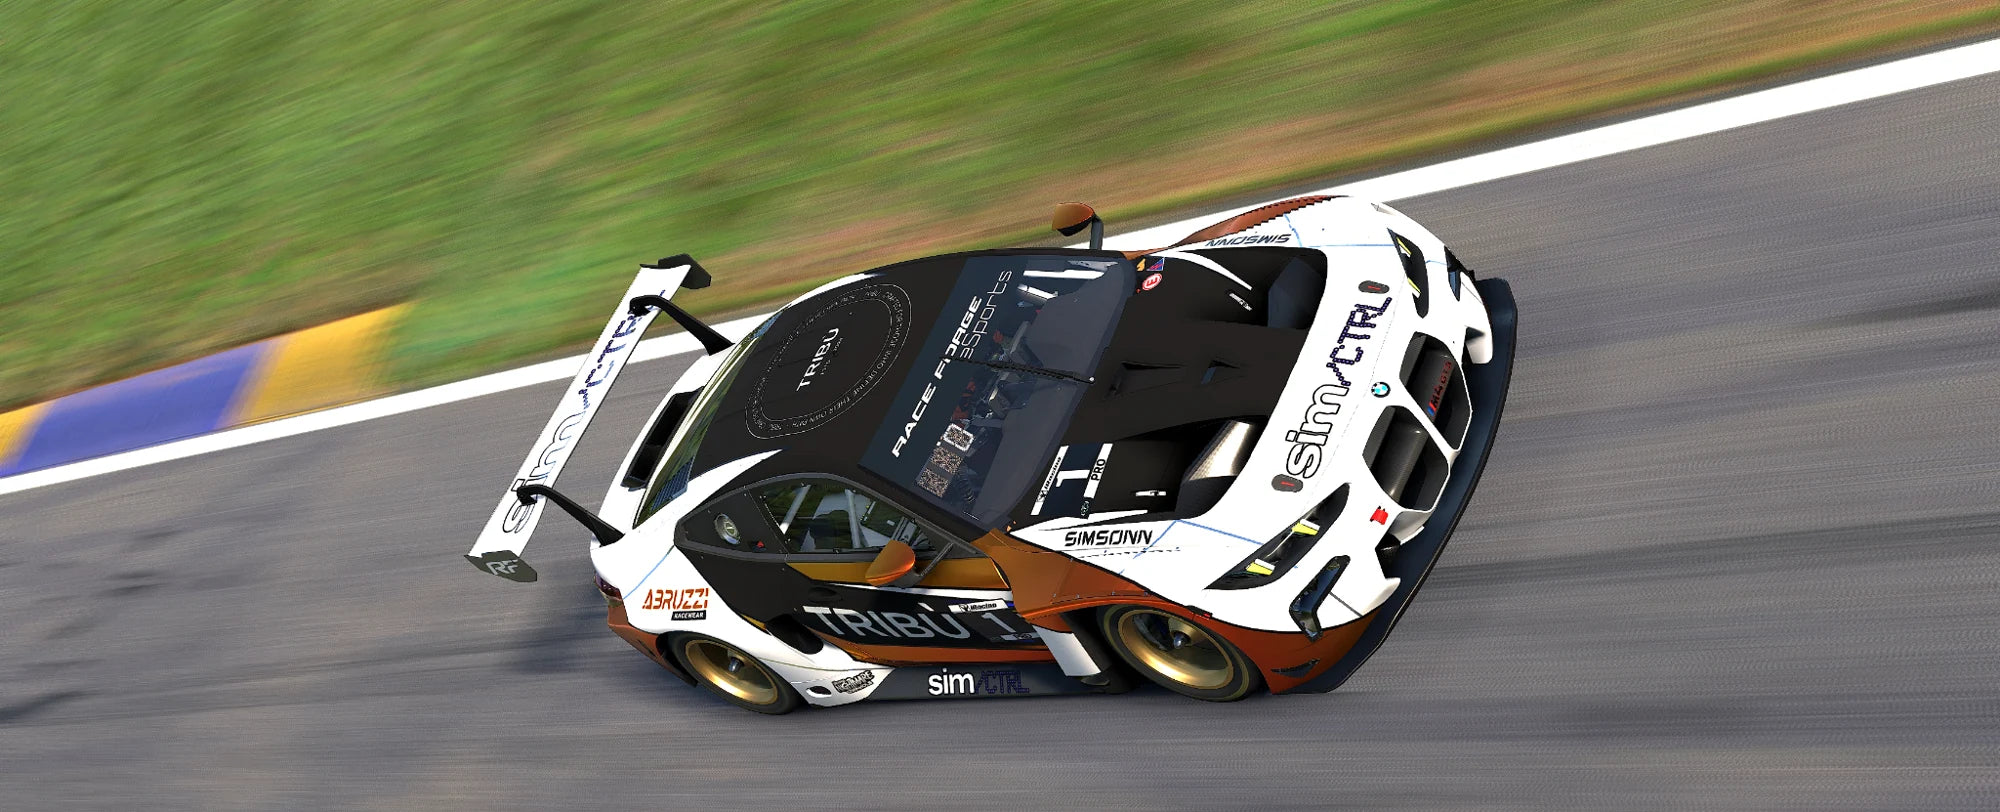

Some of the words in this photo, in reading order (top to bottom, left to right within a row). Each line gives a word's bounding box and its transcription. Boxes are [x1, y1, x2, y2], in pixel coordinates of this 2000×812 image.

[1205, 233, 1292, 247] SIMSONN
[853, 369, 877, 396] DEFINE
[891, 382, 937, 458] RACE
[934, 296, 983, 380] FORGE
[1056, 469, 1091, 487] 1
[1091, 458, 1106, 481] PRO
[1064, 530, 1153, 546] SIMSONN
[486, 559, 519, 575] RF
[642, 588, 709, 610] ABRUZZI
